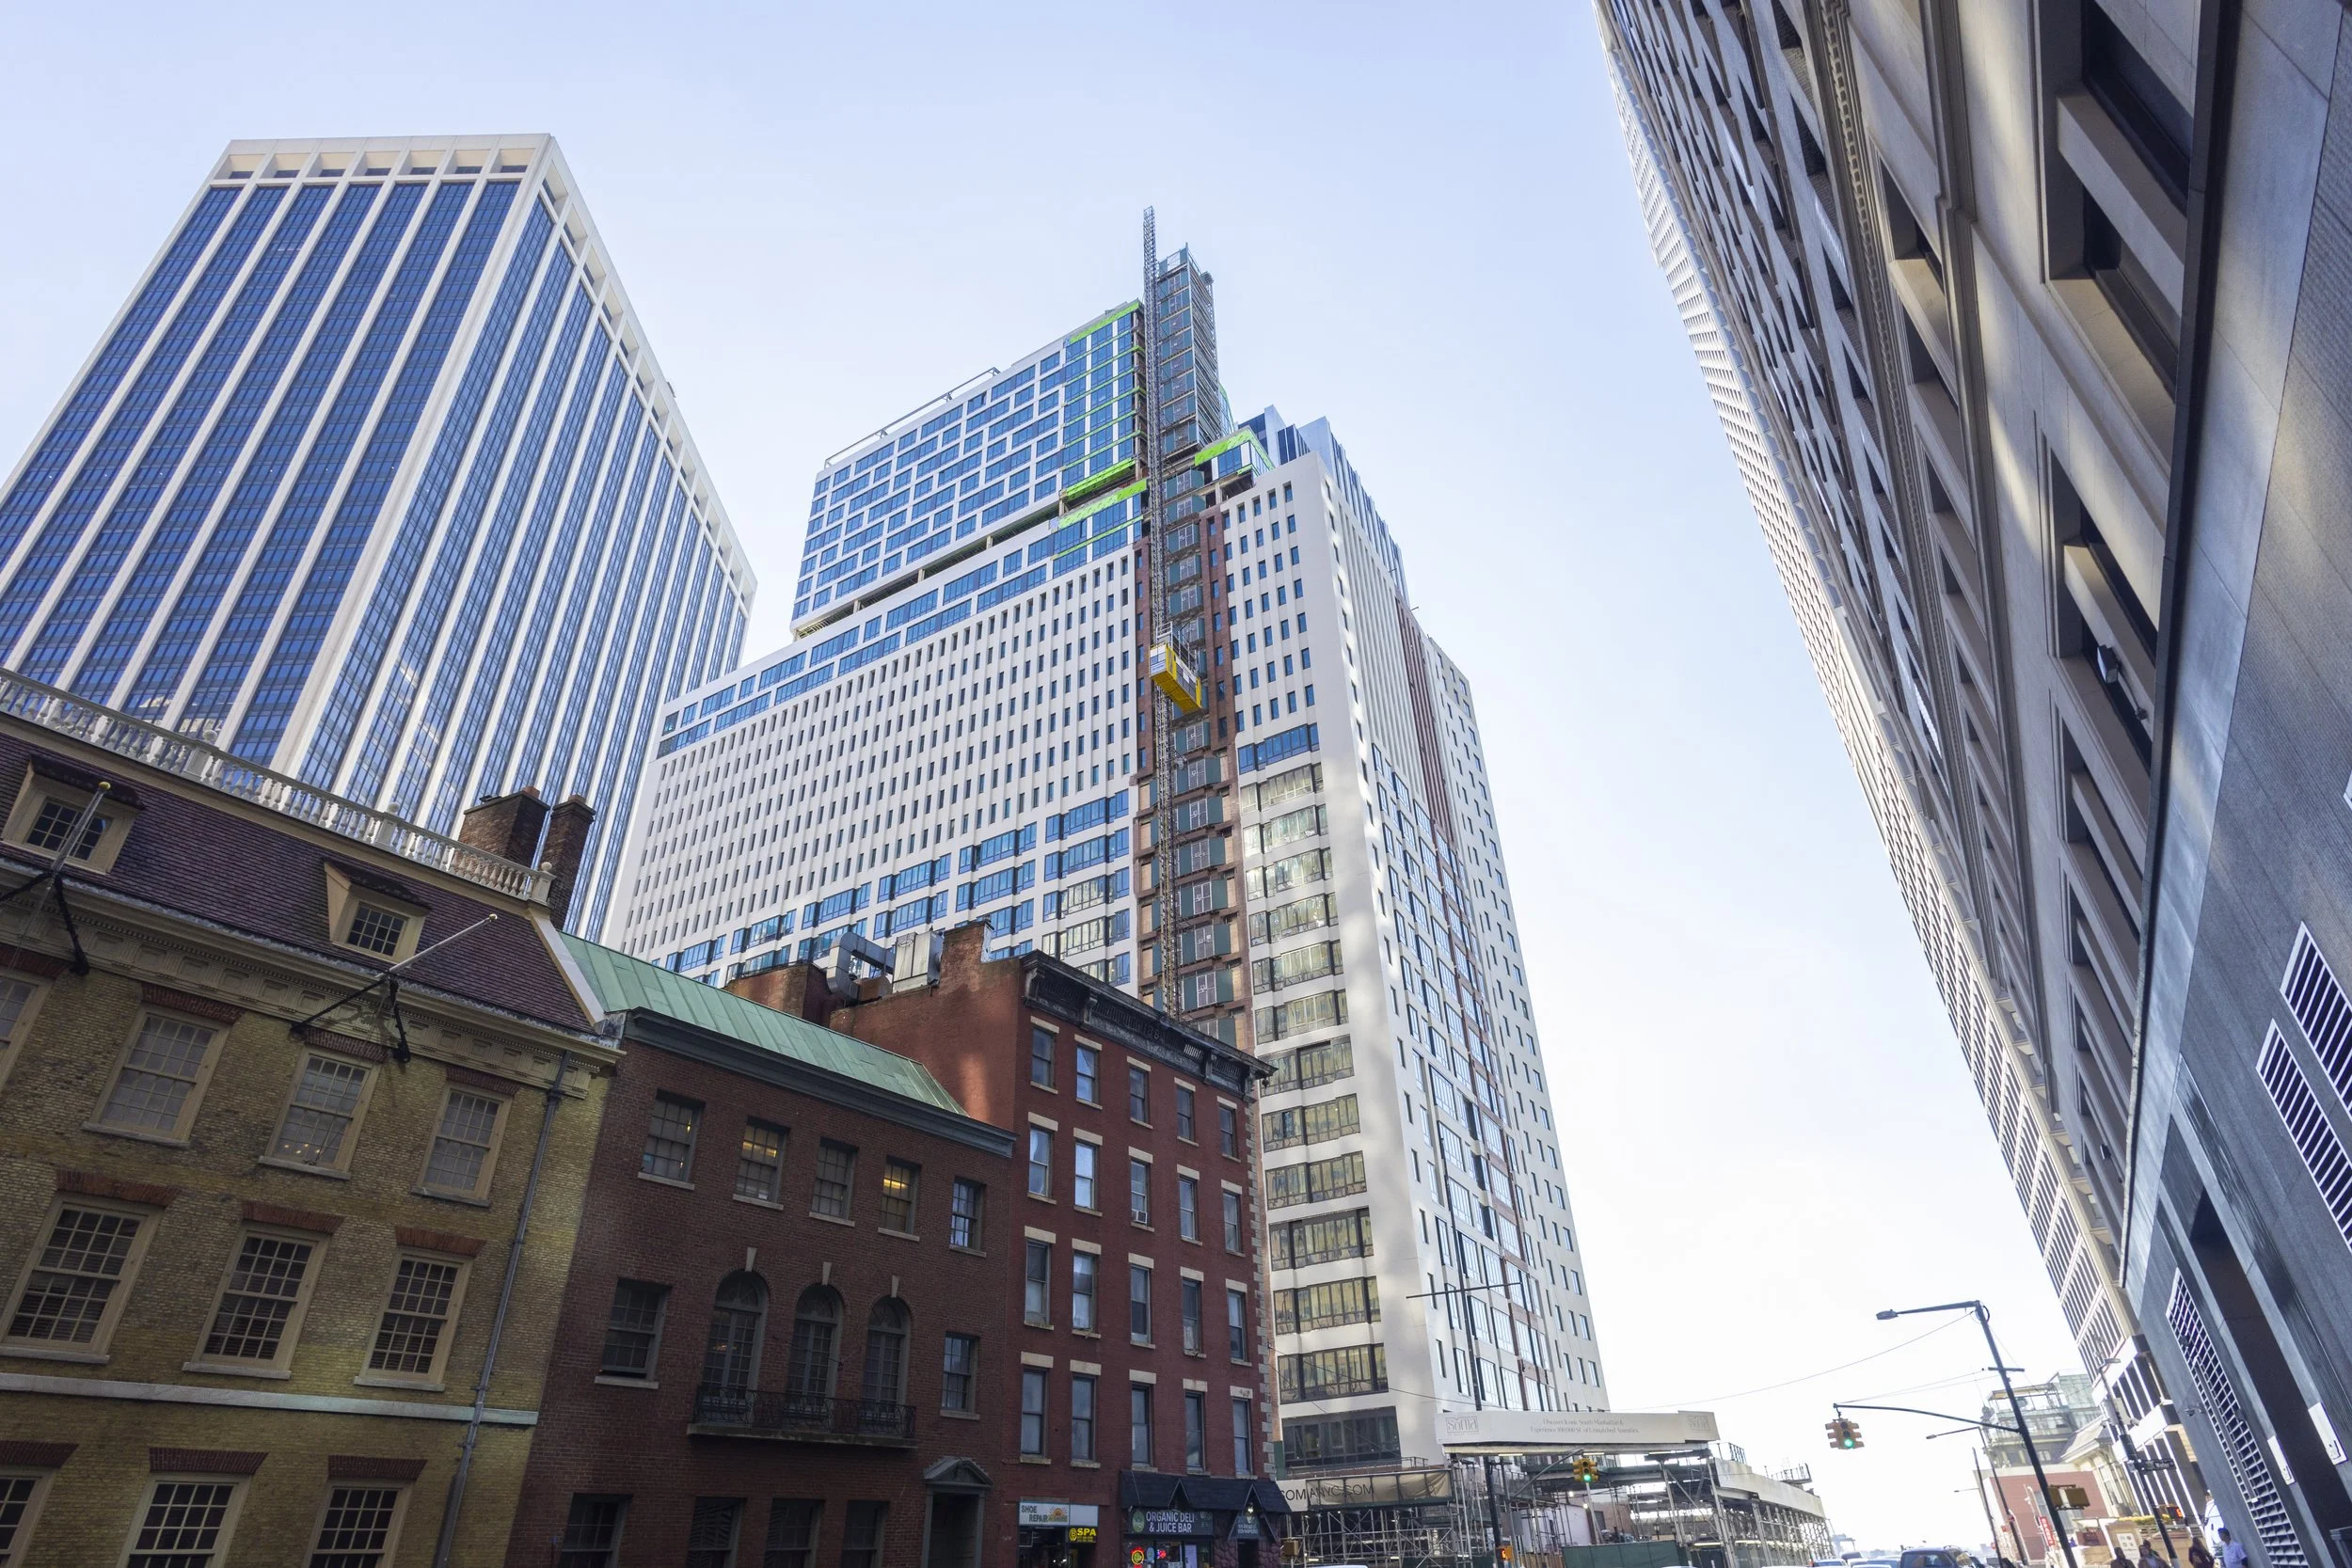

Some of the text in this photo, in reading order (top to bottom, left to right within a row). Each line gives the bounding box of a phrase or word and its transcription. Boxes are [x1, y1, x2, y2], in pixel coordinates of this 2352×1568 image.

[1021, 1505, 1038, 1514] SHOE
[1029, 1513, 1049, 1523] REPAIR
[1145, 1511, 1179, 1522] ORGANIC
[1180, 1513, 1195, 1523] DELI
[1077, 1528, 1097, 1536] SPA
[1149, 1522, 1192, 1533] & JUICE BAR
